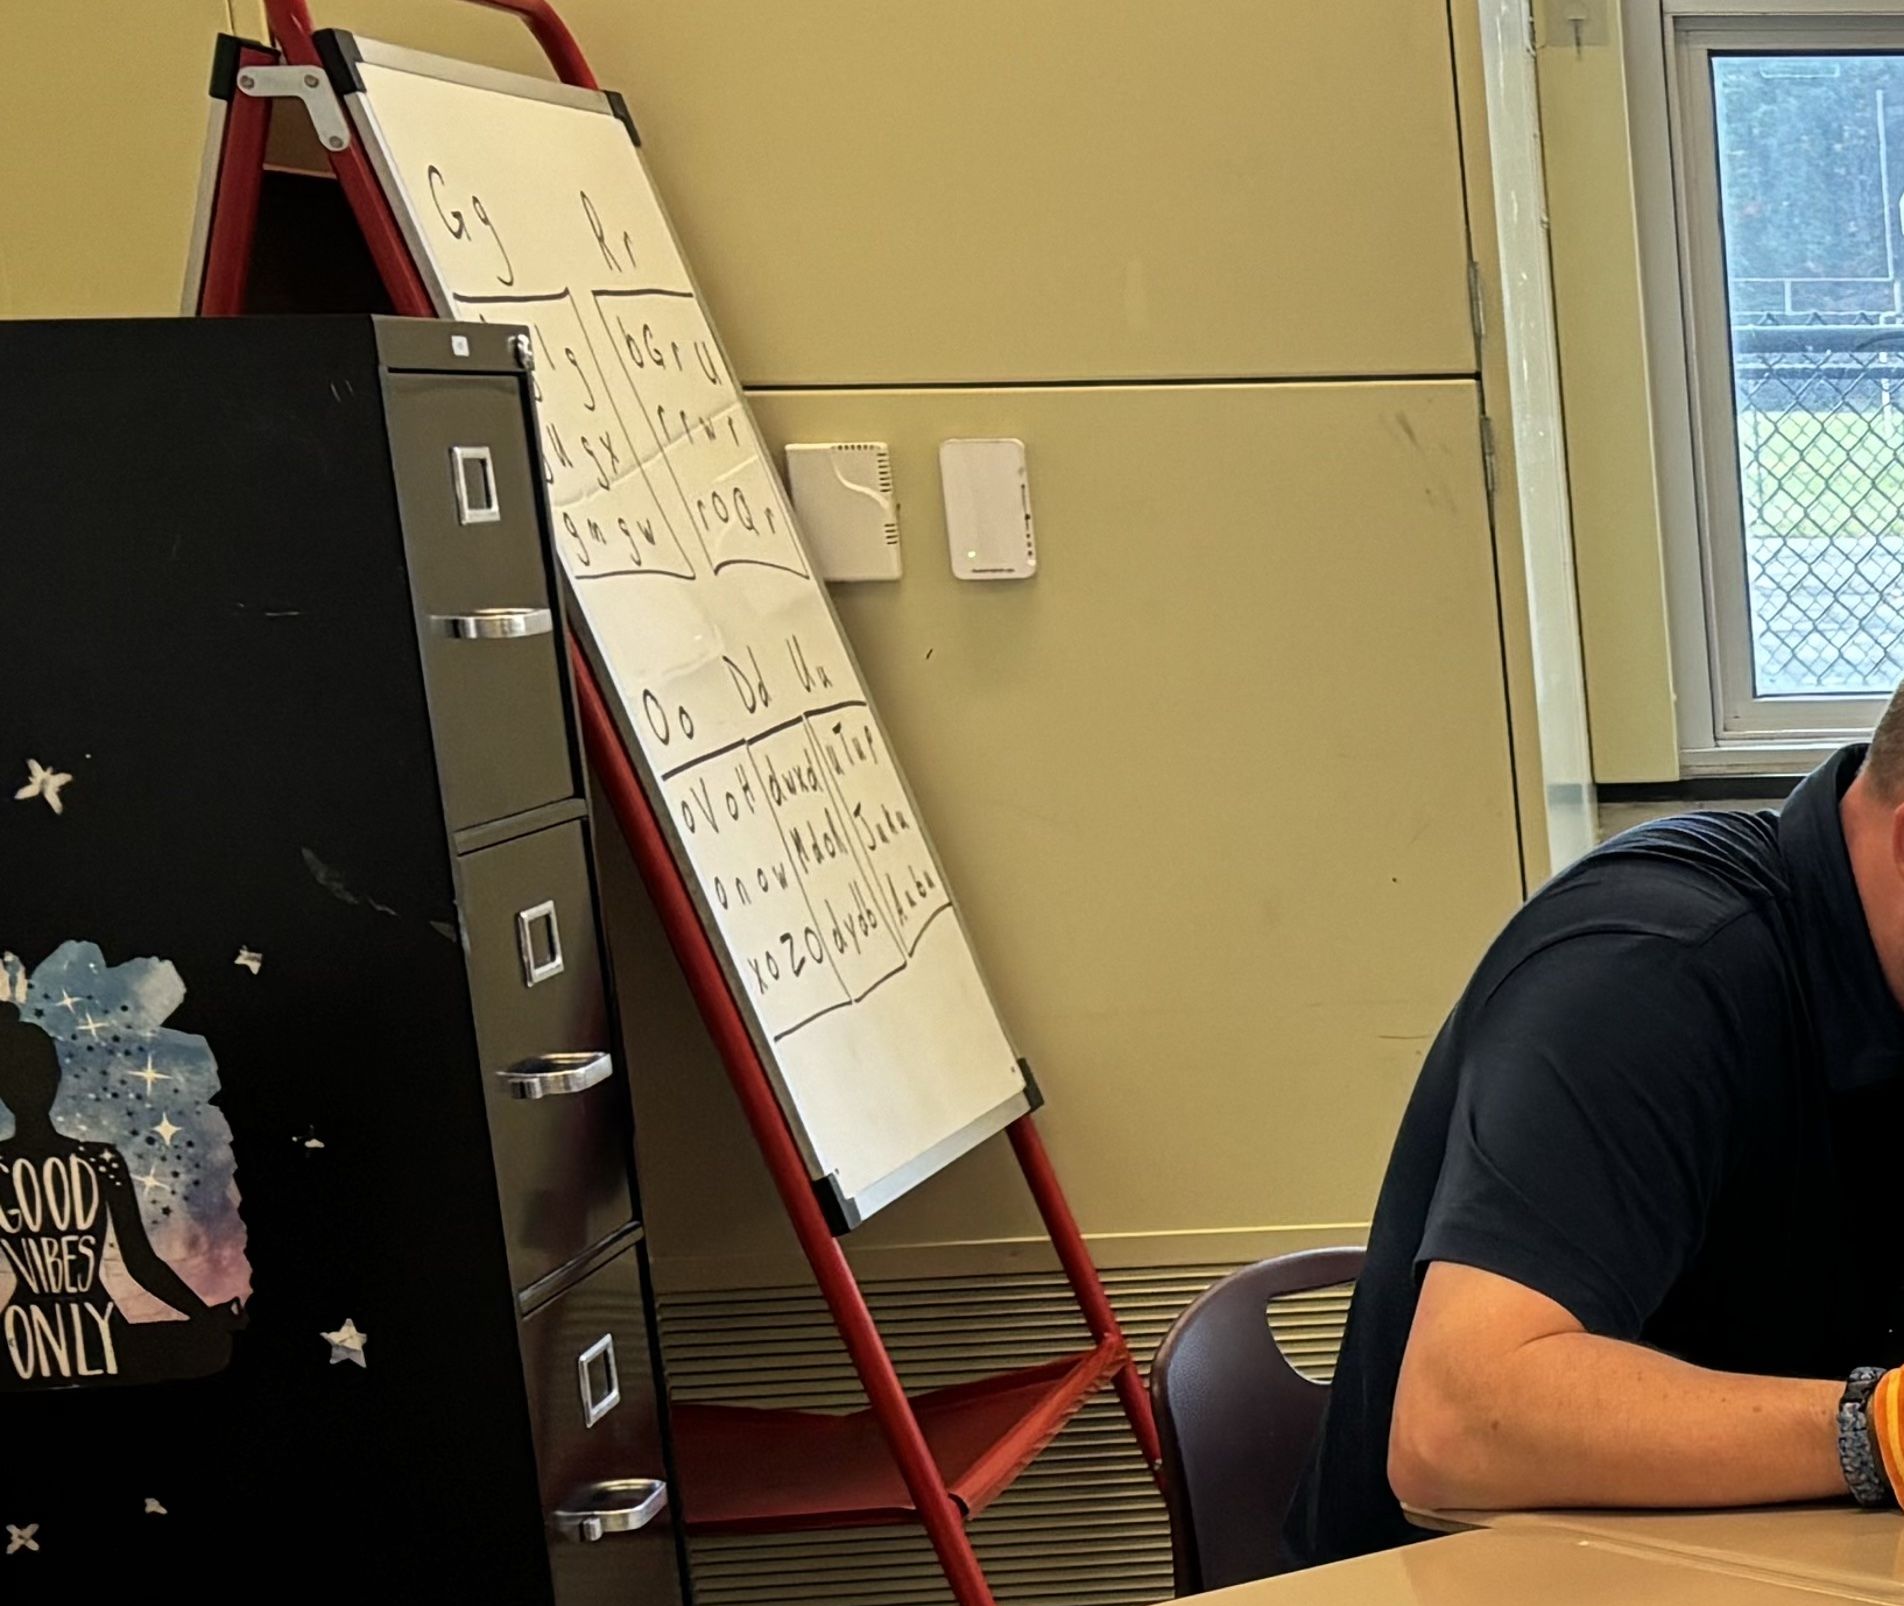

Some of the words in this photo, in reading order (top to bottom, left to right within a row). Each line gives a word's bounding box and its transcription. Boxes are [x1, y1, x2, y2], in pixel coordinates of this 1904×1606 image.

[0, 1153, 99, 1234] GOOD
[1, 1235, 96, 1294] VIBES
[4, 1302, 118, 1380] ONLY
